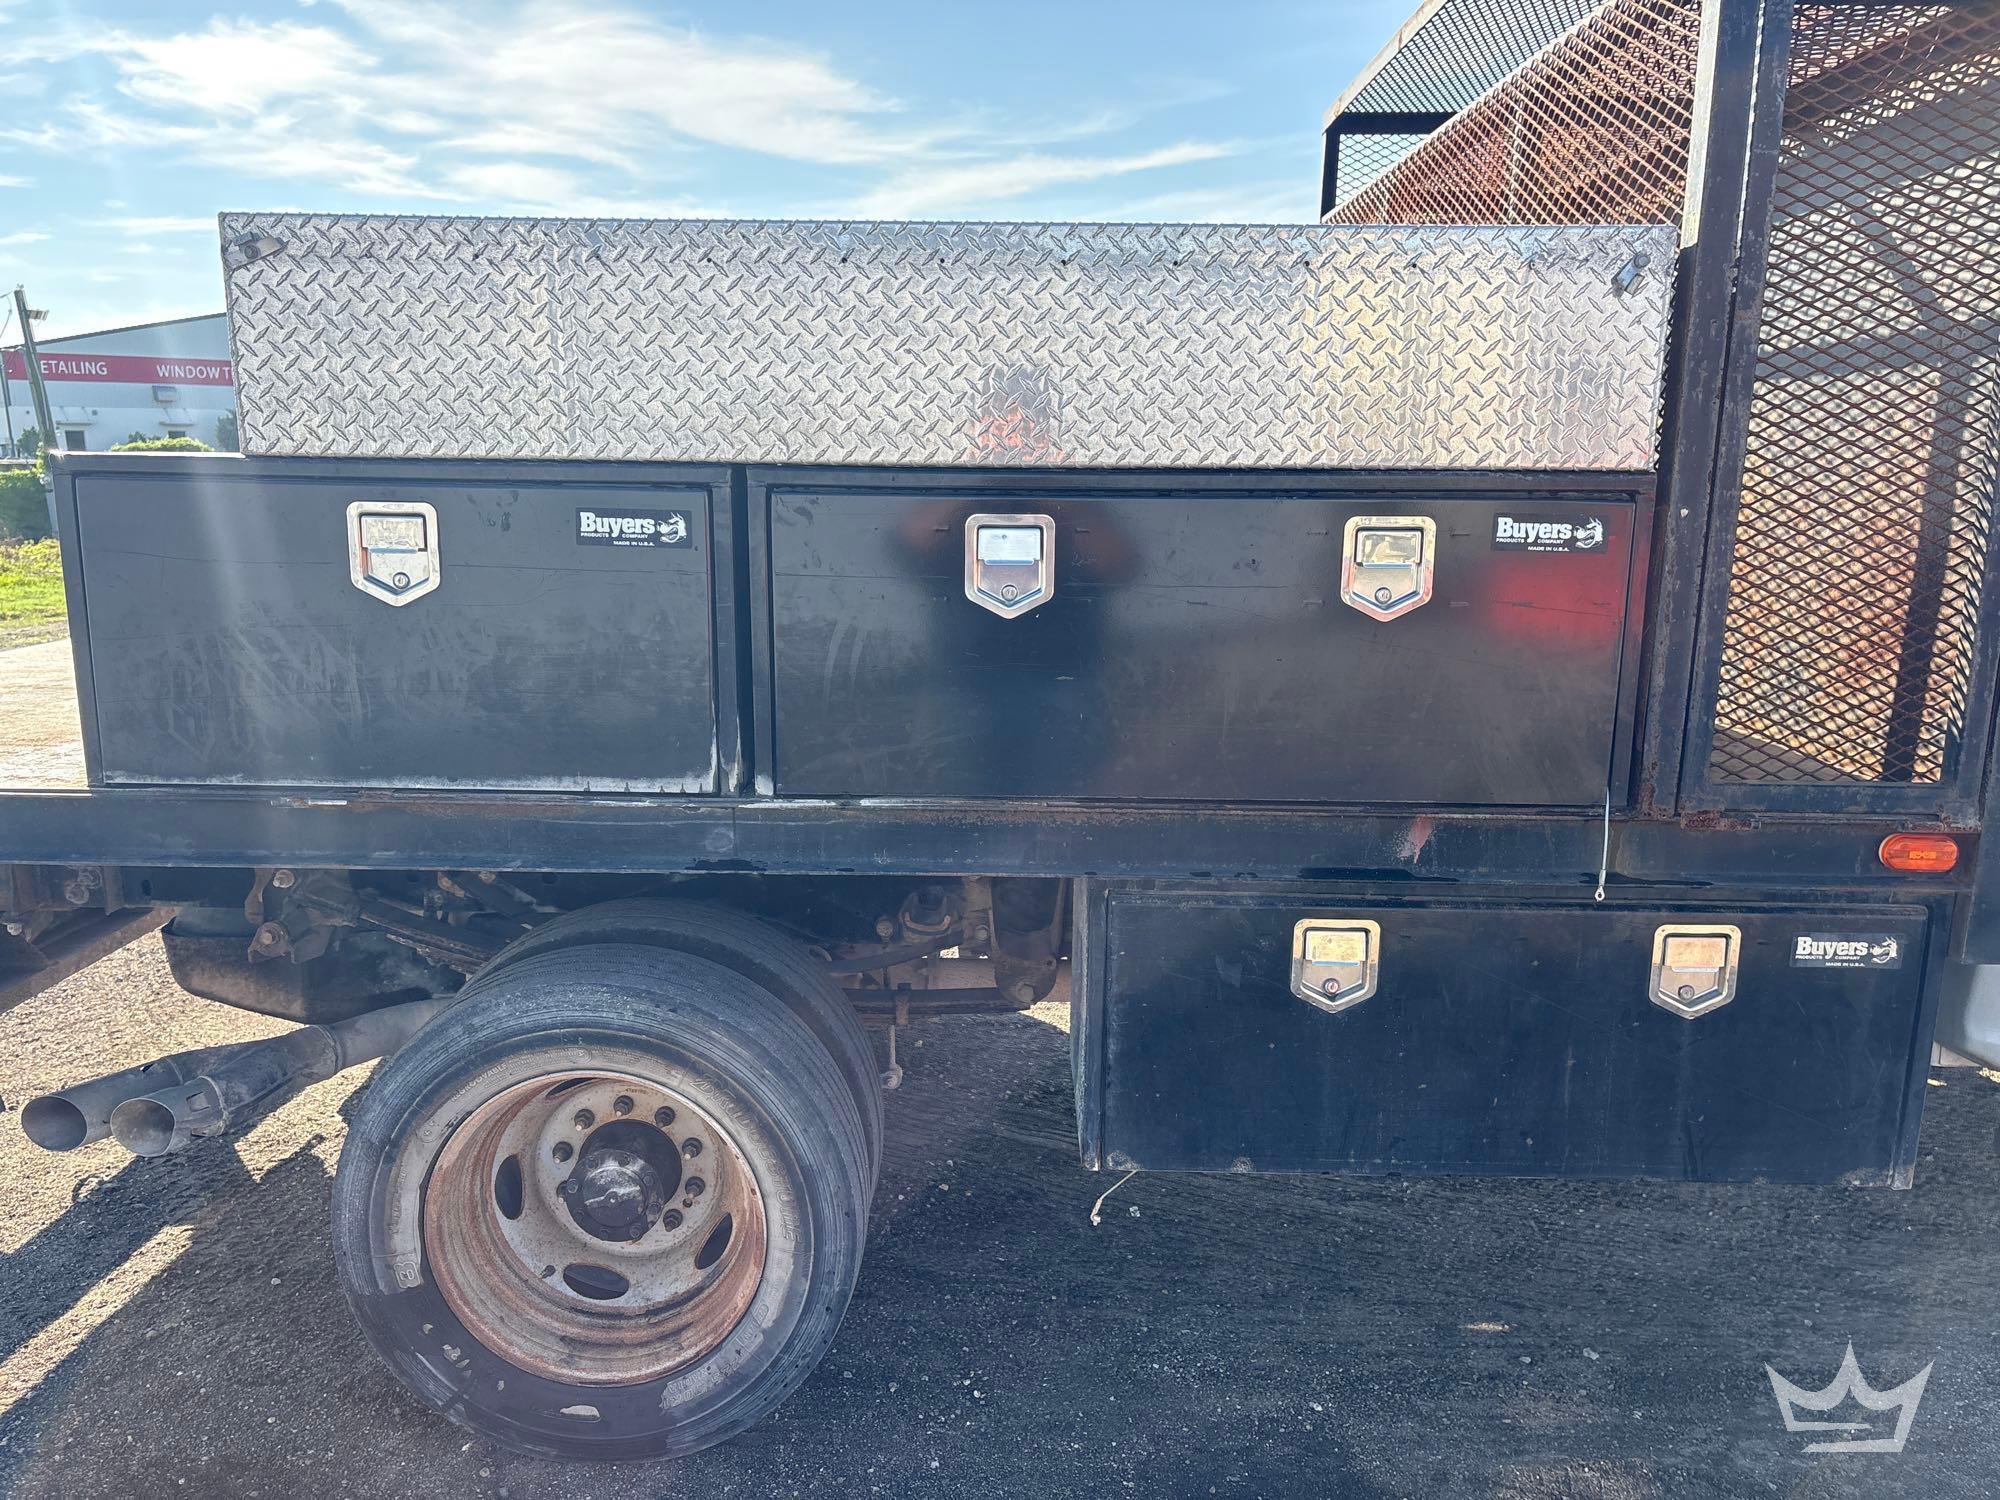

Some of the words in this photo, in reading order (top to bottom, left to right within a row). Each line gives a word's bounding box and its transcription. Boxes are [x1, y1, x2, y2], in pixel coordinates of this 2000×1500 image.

[40, 360, 108, 376] ETAILING
[156, 364, 220, 379] WINDOW
[580, 512, 655, 537] Buyers
[1496, 517, 1572, 543] Buyers
[1796, 937, 1868, 959] Buyers
